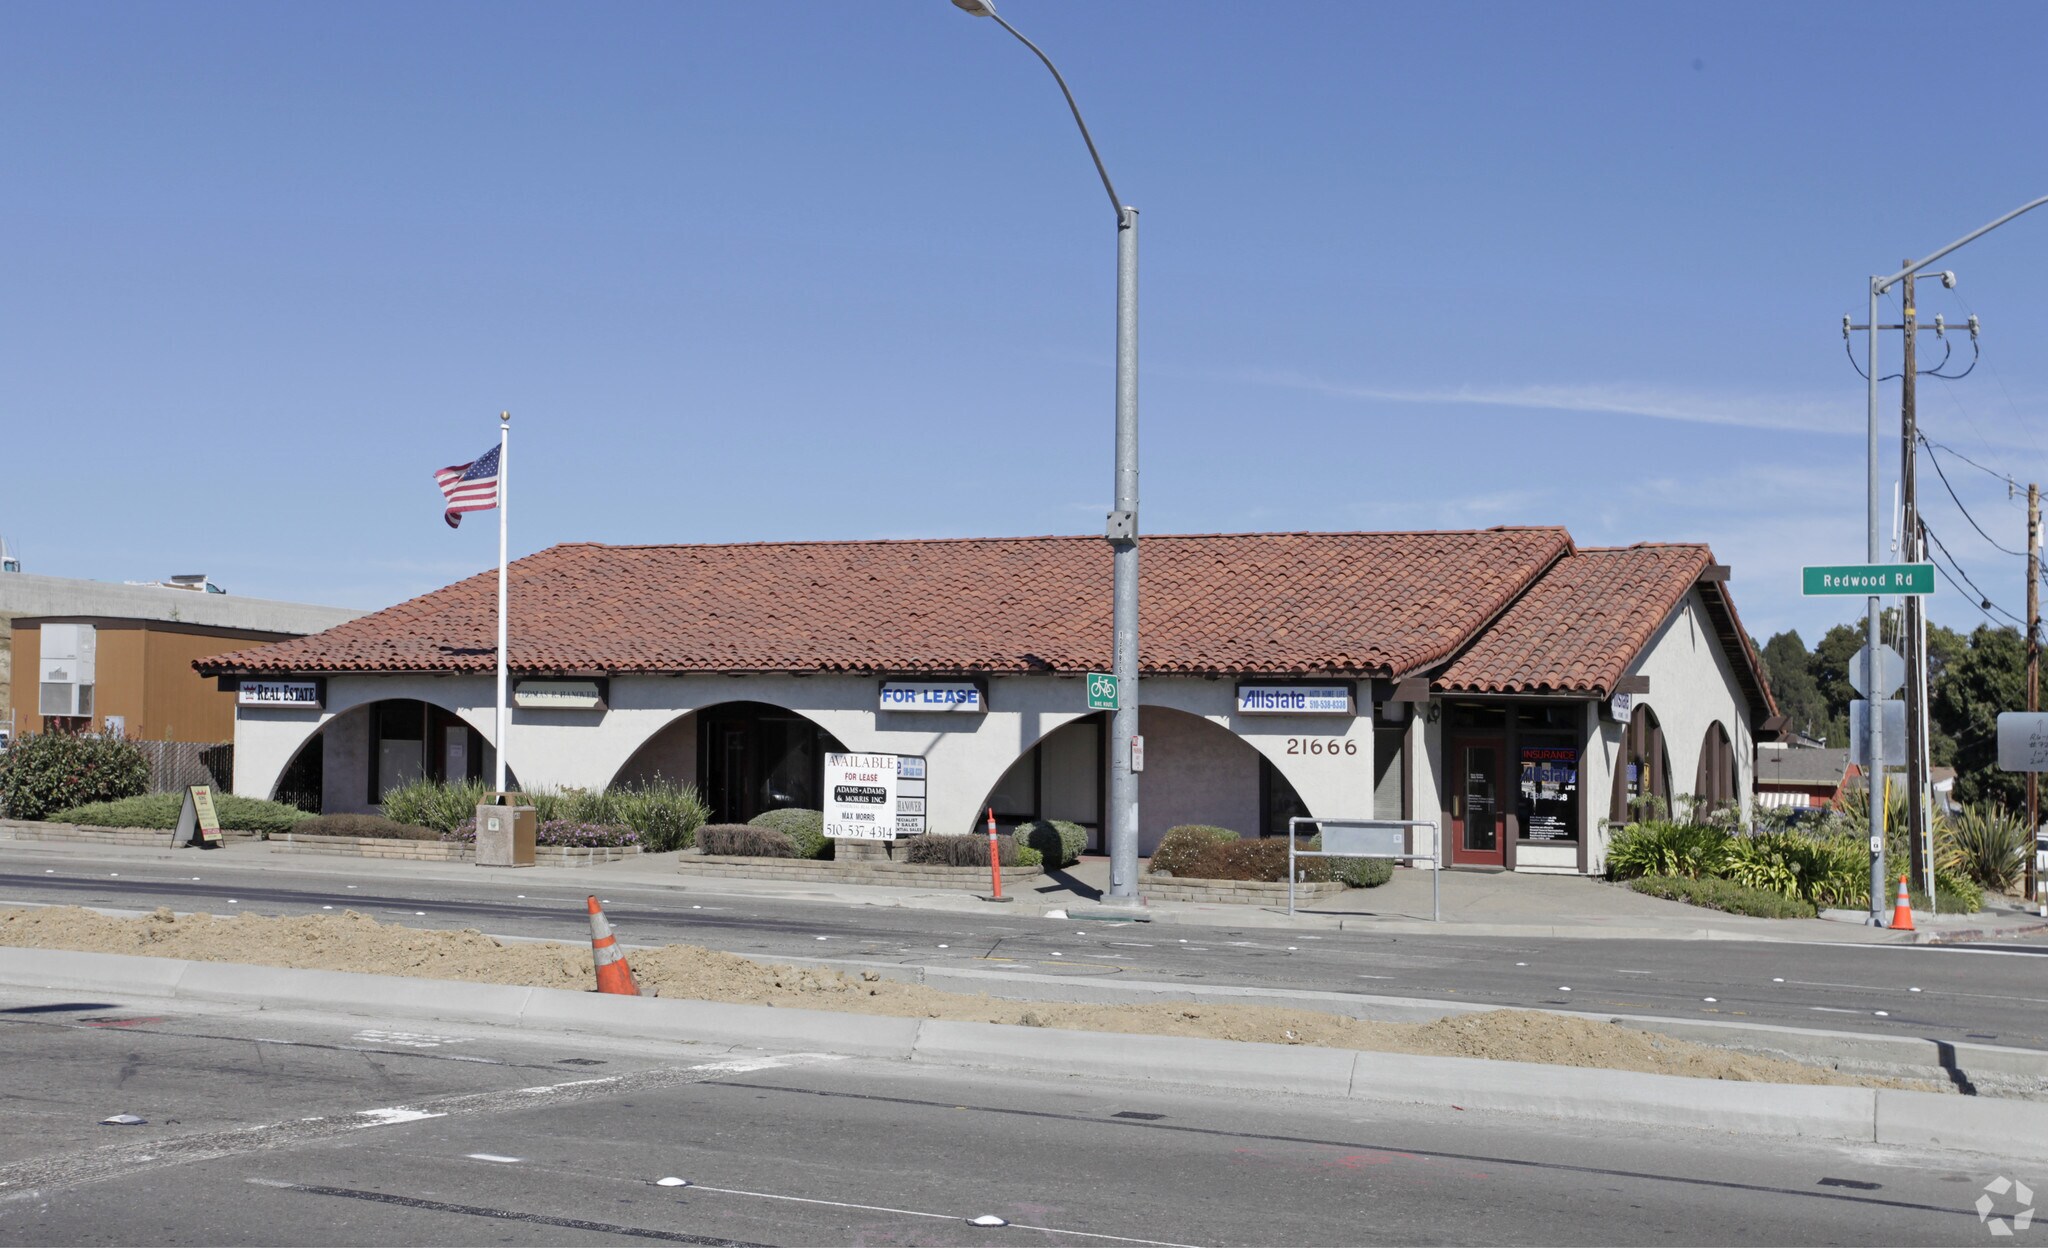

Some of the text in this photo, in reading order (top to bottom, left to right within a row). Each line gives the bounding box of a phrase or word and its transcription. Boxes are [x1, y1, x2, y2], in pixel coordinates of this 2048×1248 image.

[1823, 573, 1913, 587] Redwood Rd
[258, 684, 315, 702] REAL ESTATE
[882, 689, 978, 704] FOR LEASE
[1243, 690, 1305, 709] Allstate
[1309, 690, 1346, 698] AUTO HOME LIFE
[1287, 738, 1357, 756] 21666
[828, 755, 894, 769] AVAILABLE
[1523, 750, 1576, 760] INSURANCE
[845, 772, 878, 782] FOR LEASE
[836, 786, 885, 795] ADAMS ADAMS
[841, 812, 875, 821] MAX MORRIS
[826, 823, 893, 839] 510-537-4314
